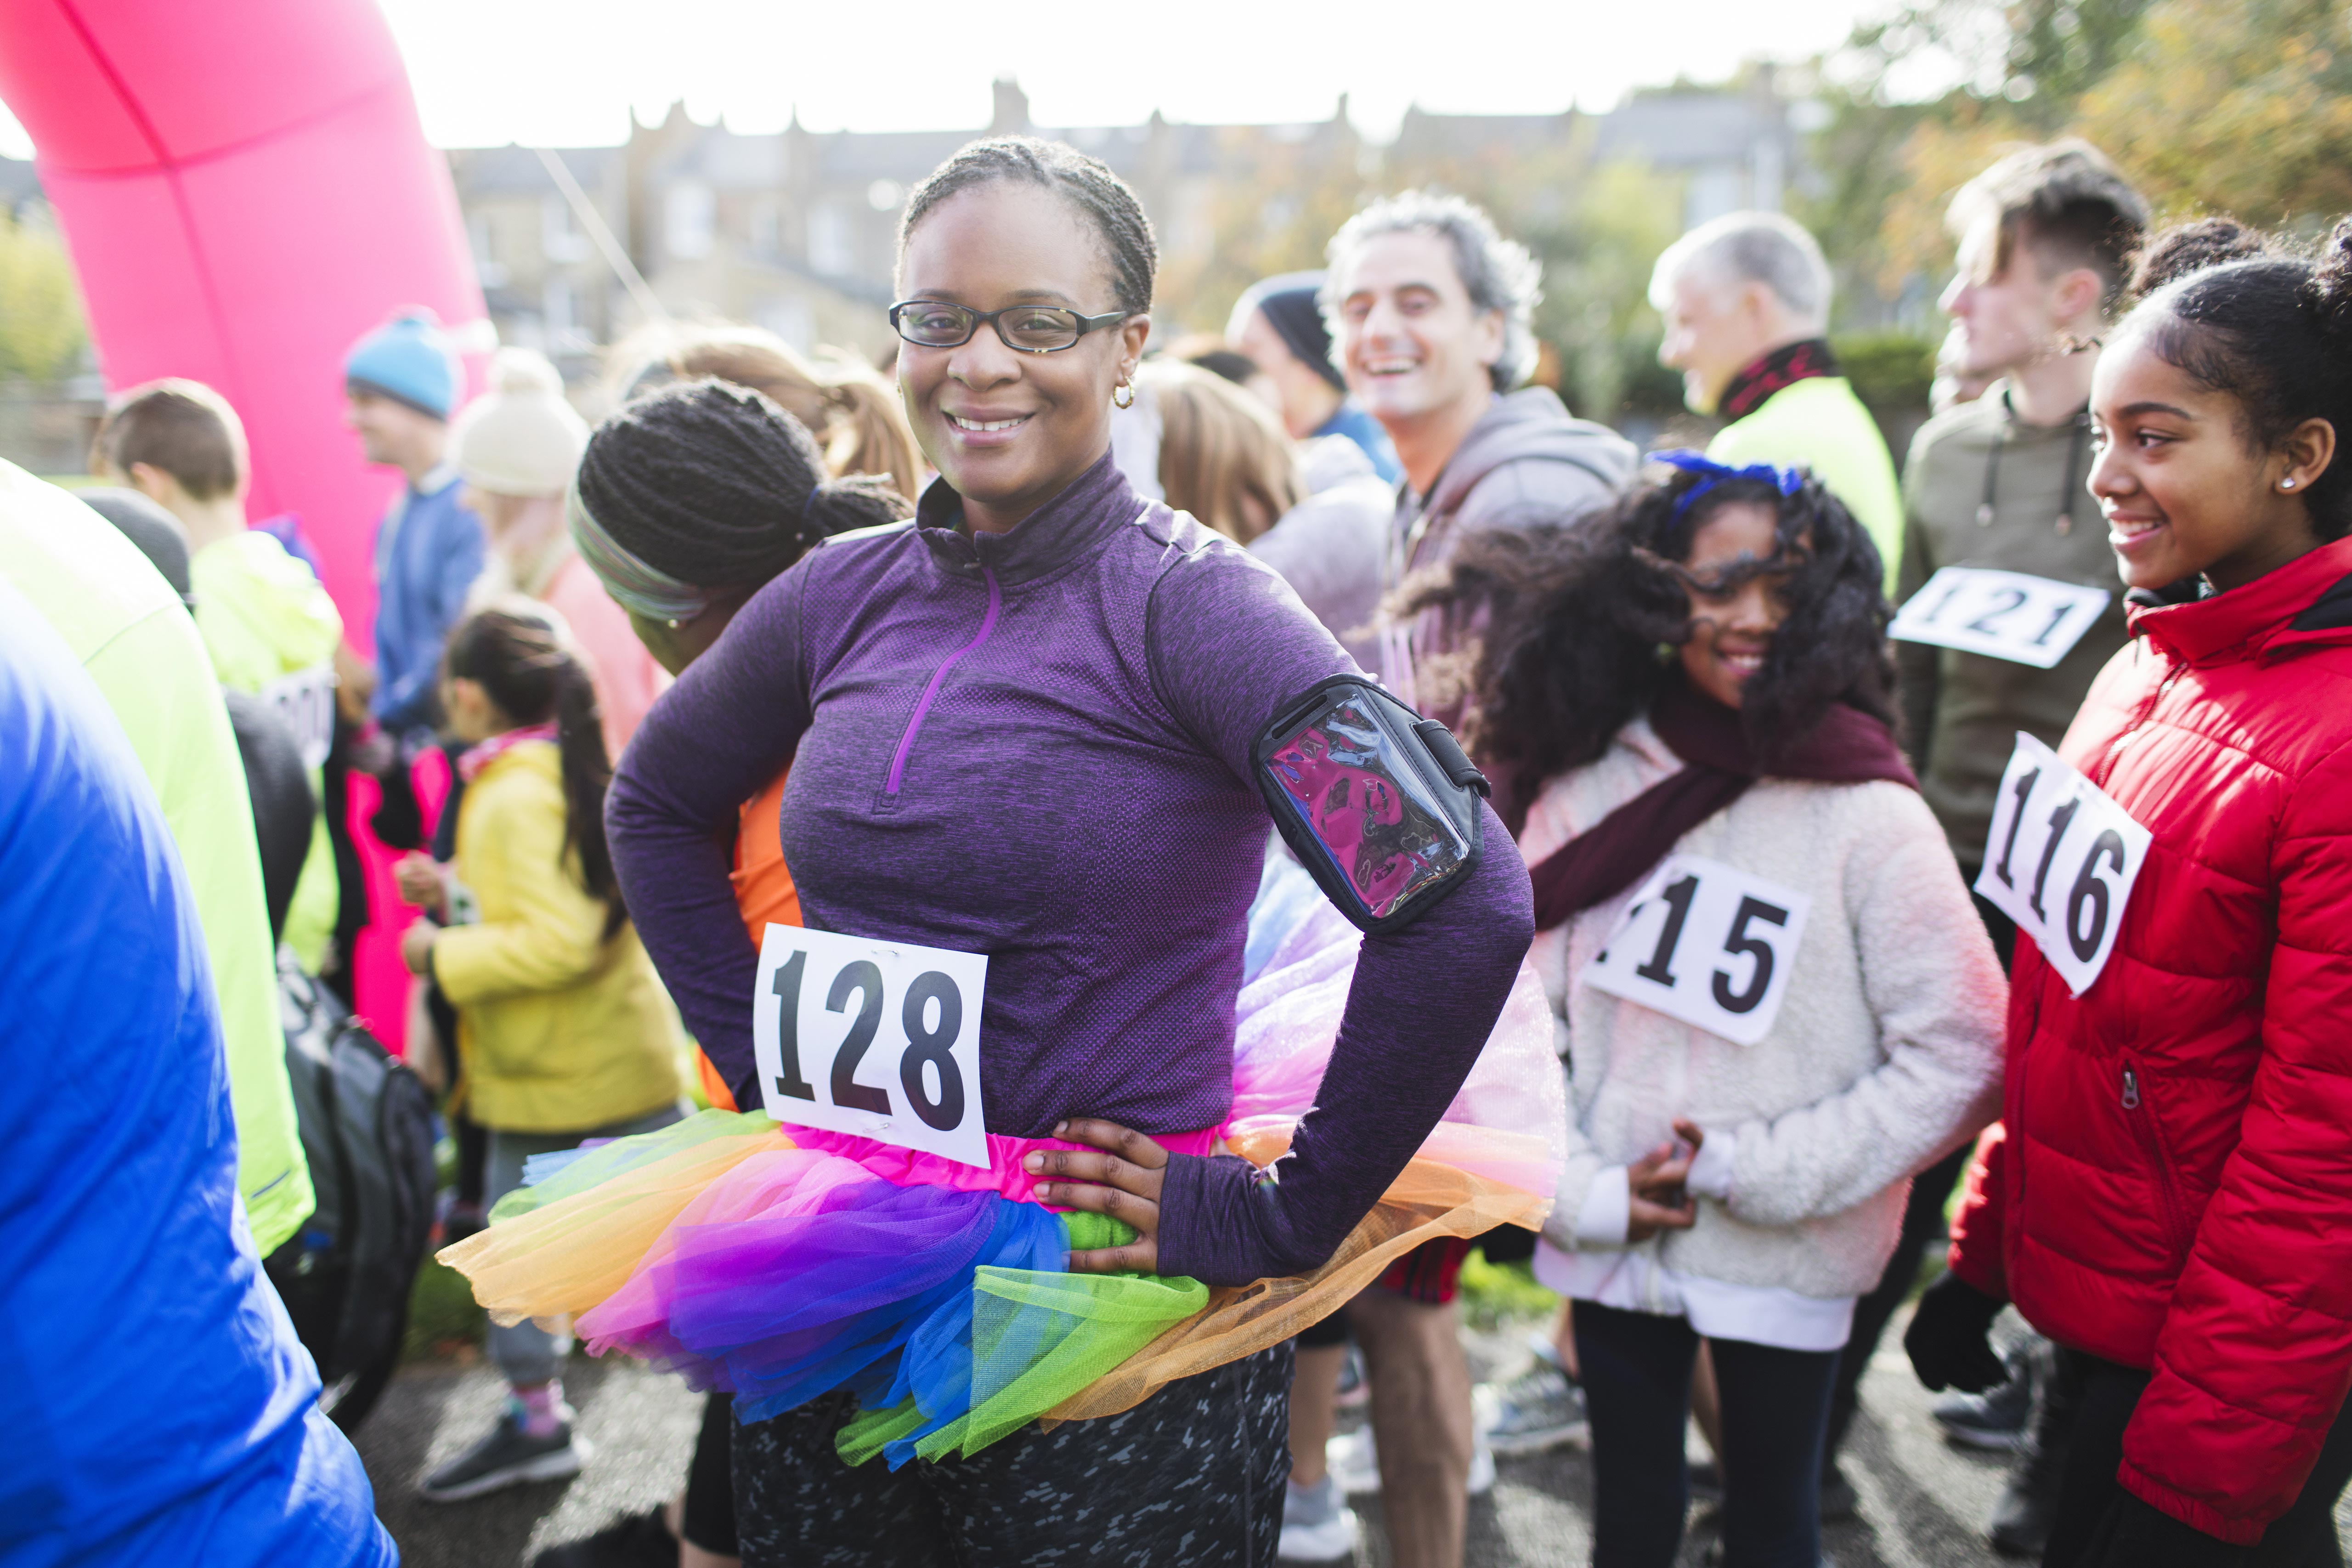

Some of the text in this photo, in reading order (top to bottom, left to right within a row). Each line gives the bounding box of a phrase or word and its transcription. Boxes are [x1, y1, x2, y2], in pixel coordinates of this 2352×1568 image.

[1917, 581, 2076, 646] 121
[1596, 875, 1790, 1014] 15
[1996, 766, 2125, 963] 116
[772, 949, 965, 1132] 128
